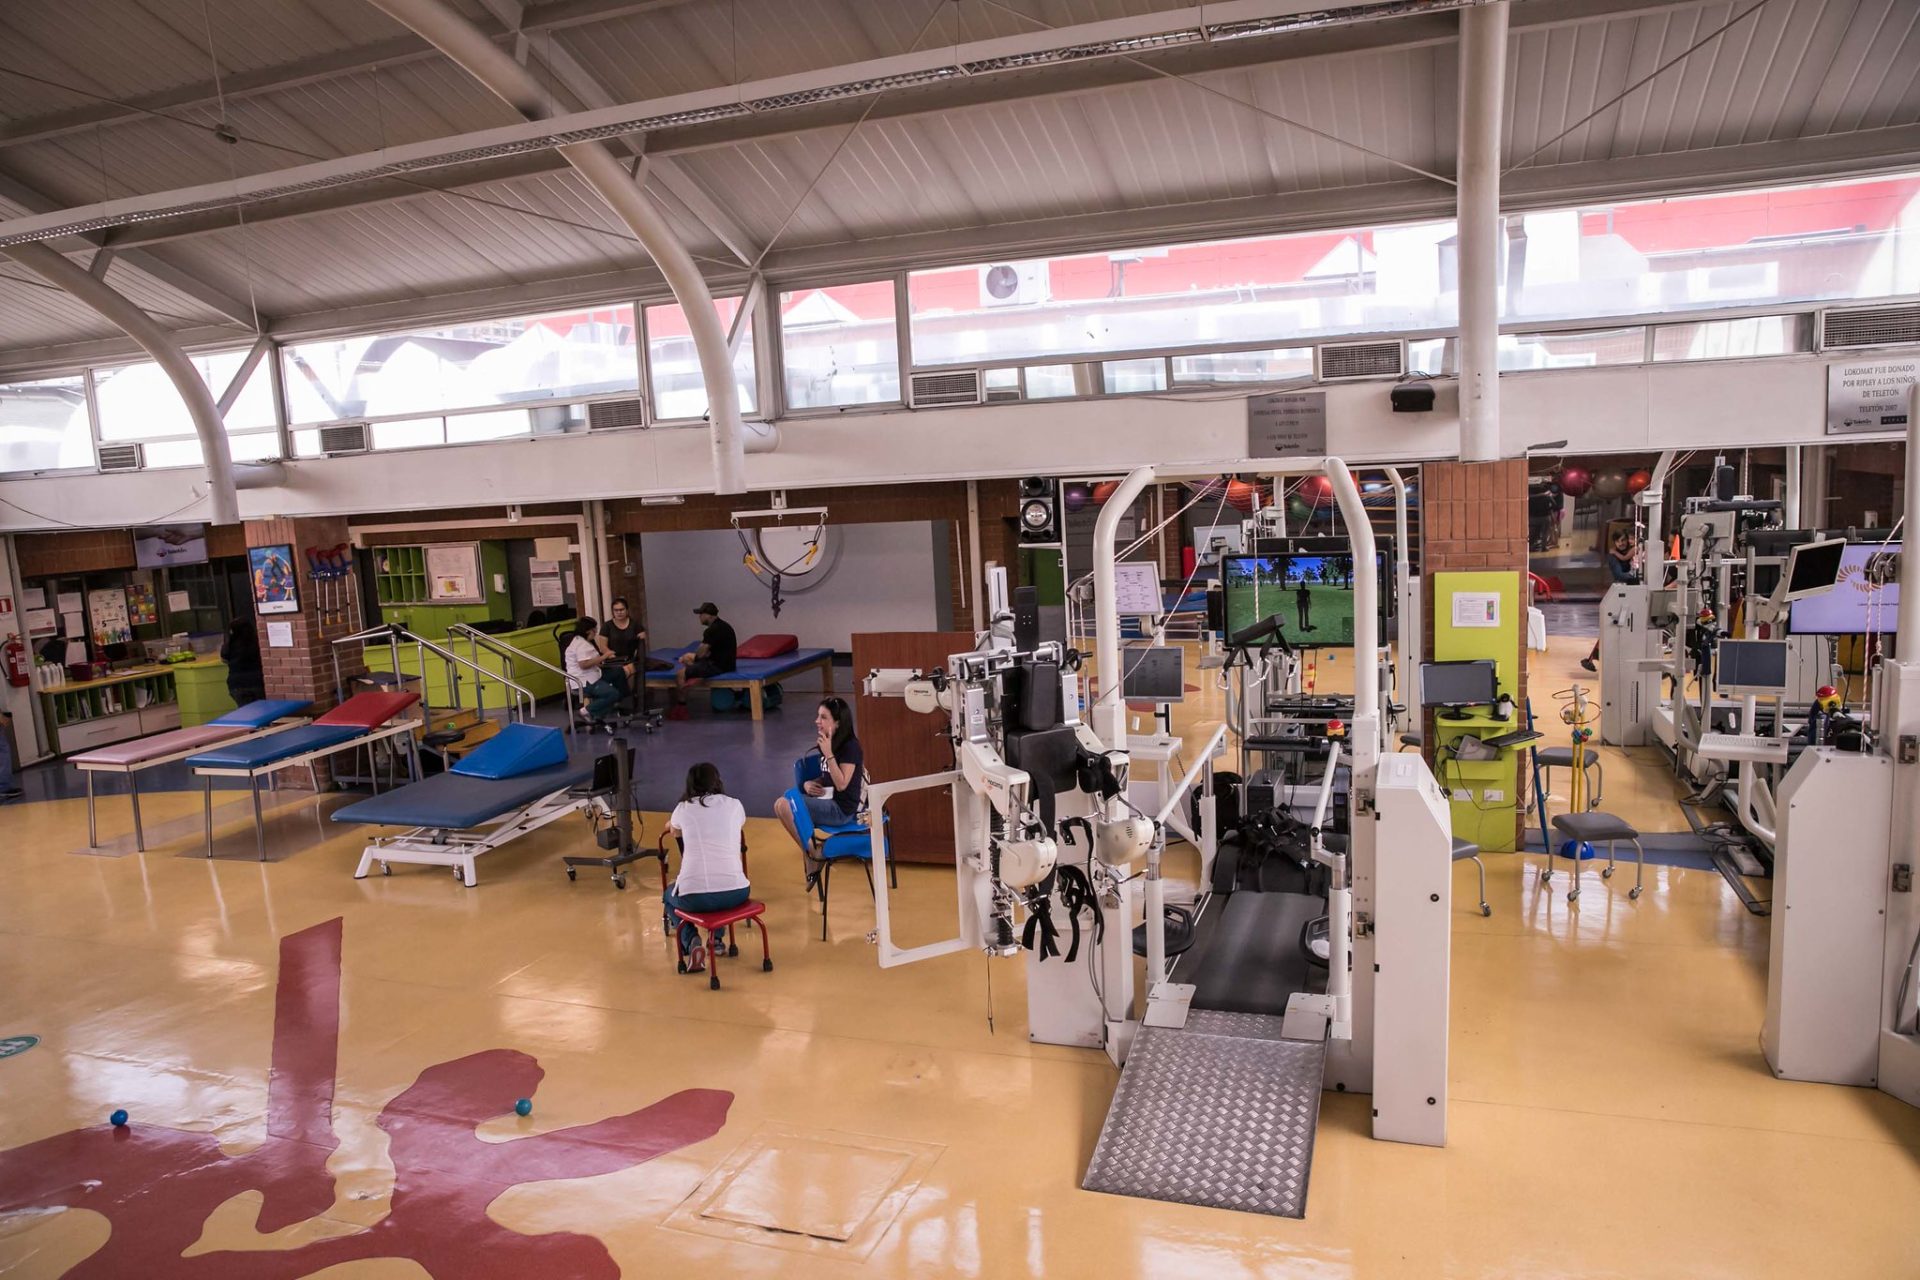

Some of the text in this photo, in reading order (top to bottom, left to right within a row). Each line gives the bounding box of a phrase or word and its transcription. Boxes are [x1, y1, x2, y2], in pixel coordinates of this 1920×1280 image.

[1844, 364, 1915, 376] LOKOMAT FUE DONADO
[1842, 379, 1854, 387] POR
[1856, 378, 1876, 387] RIPLEY
[1883, 377, 1895, 385] LOS
[1896, 375, 1916, 384] NIÑOS
[1862, 390, 1870, 398] DE
